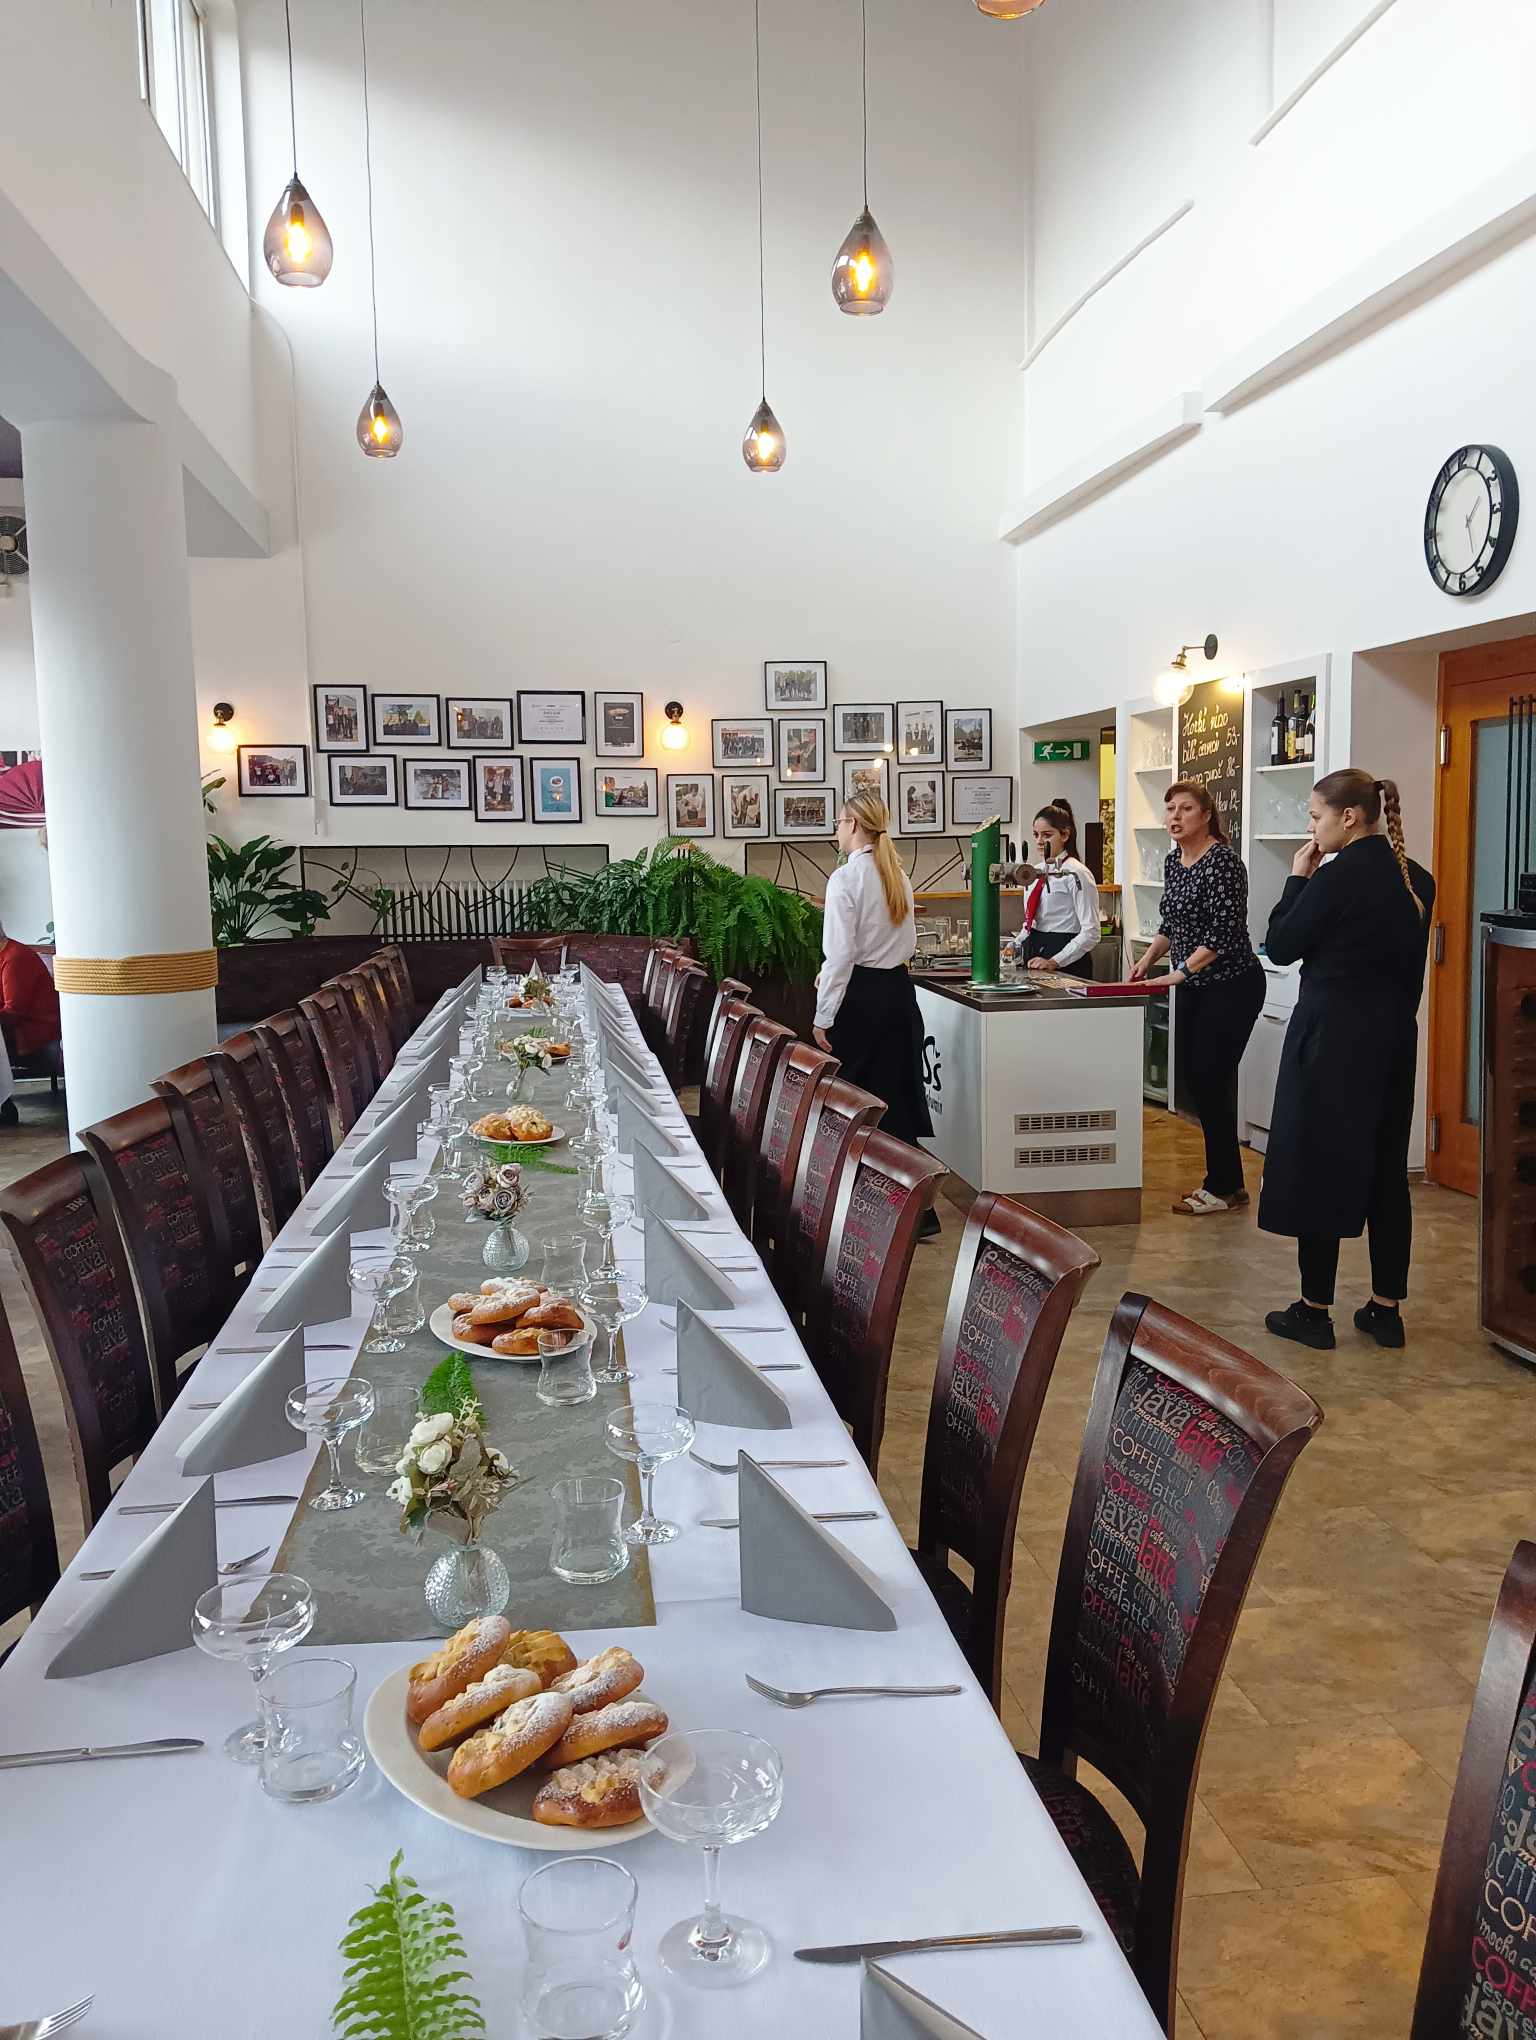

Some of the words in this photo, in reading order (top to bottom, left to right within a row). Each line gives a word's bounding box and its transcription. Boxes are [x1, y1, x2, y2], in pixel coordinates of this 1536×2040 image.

[1157, 1386, 1202, 1415] espresso
[1113, 1428, 1164, 1477] COFFEE
[1480, 1917, 1517, 1966] mocha
